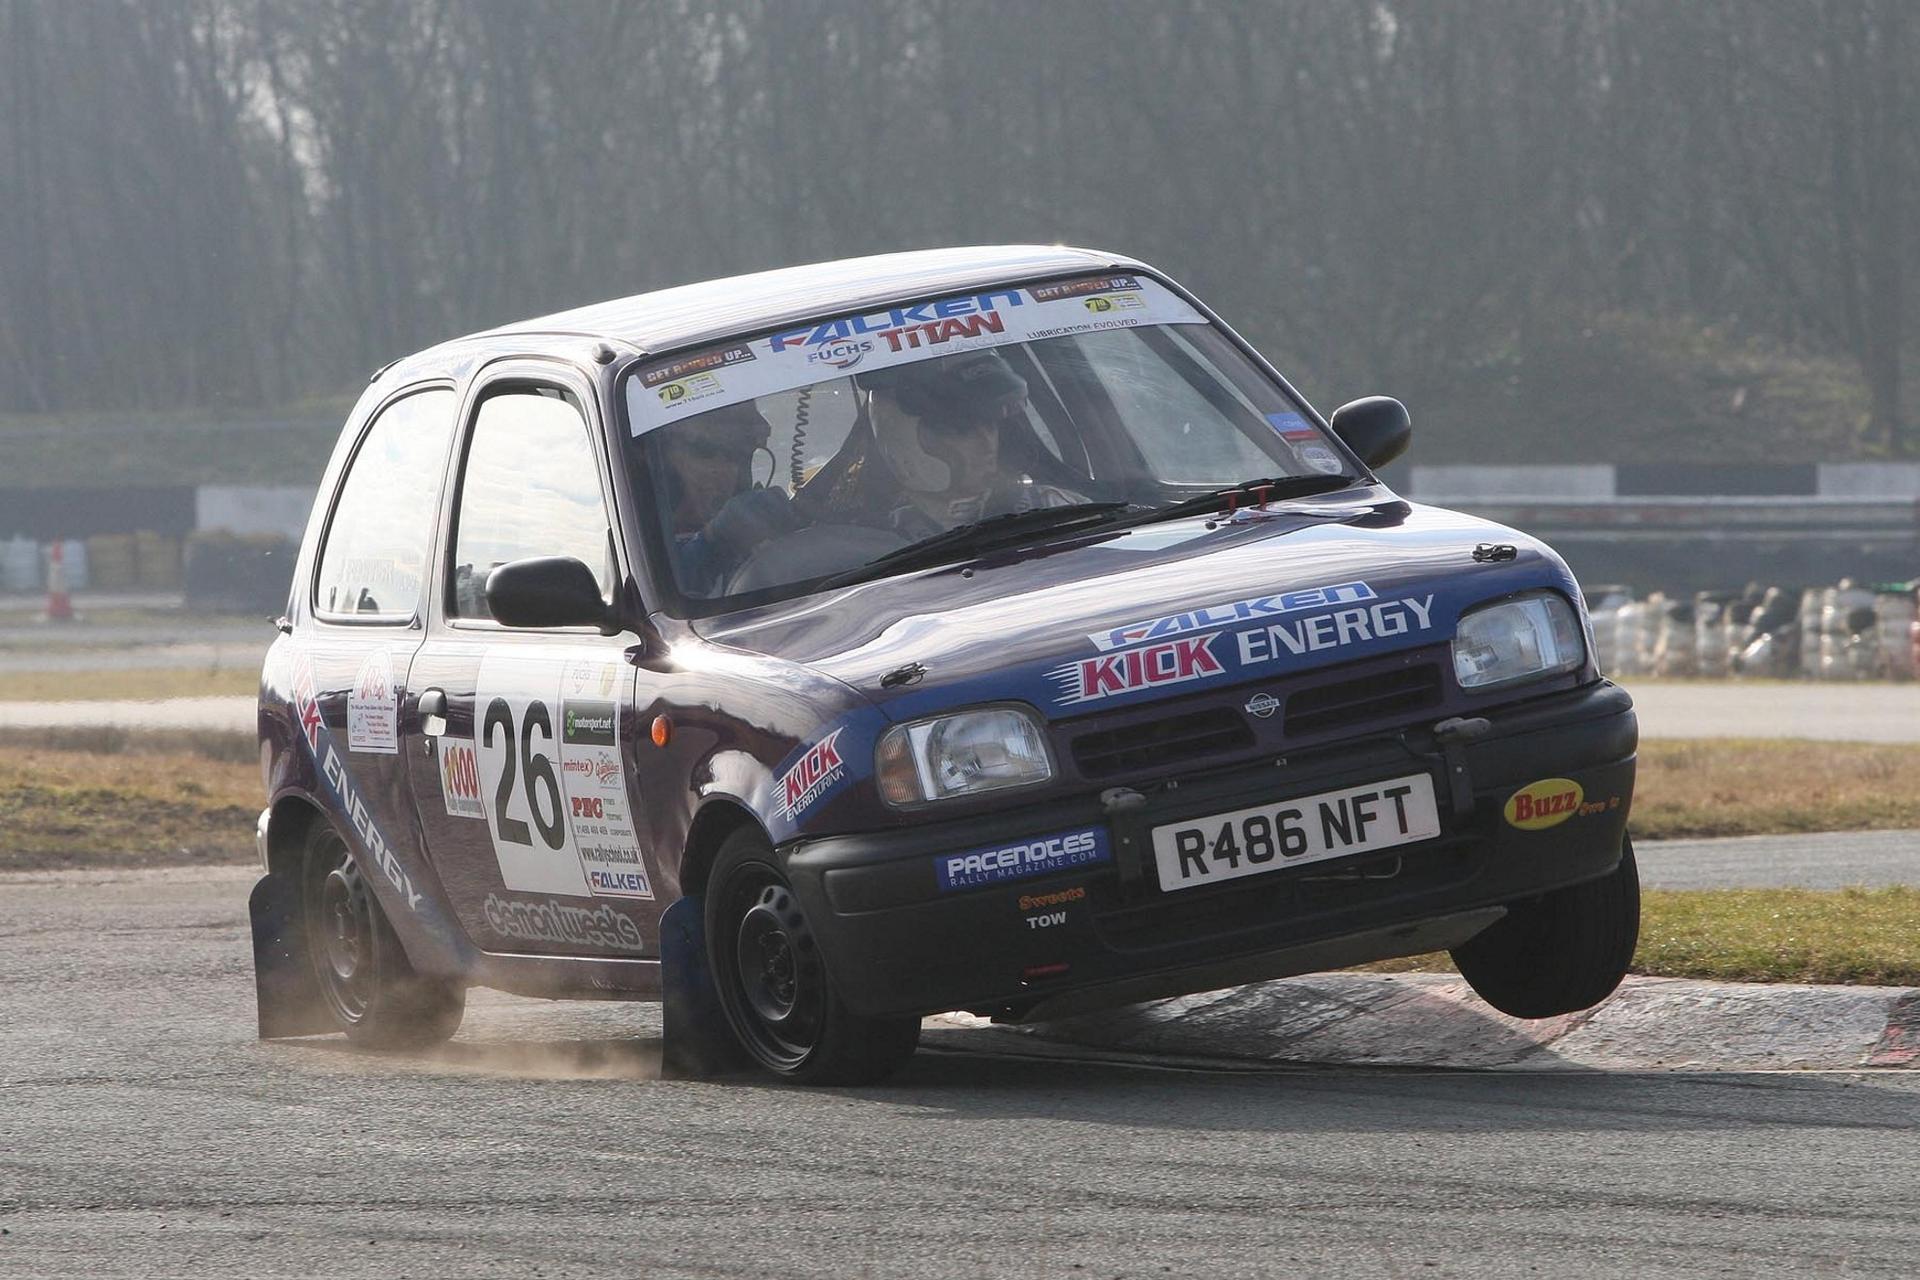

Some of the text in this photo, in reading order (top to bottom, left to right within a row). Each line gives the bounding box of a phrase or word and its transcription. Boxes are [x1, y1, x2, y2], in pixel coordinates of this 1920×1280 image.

[1036, 287, 1059, 299] GET
[768, 290, 1024, 353] FALKEN
[1026, 318, 1138, 339] LUBRICATION EVOLVED
[807, 339, 875, 363] FUCHS
[646, 368, 672, 382] GET
[1108, 584, 1373, 647] FALKEN
[1080, 594, 1434, 697] KICK ENERGY
[574, 717, 611, 731] motorsport.net
[483, 697, 565, 850] 26
[564, 760, 589, 772] mintex
[784, 733, 841, 809] KICK
[1515, 792, 1577, 822] Buzz
[323, 744, 423, 911] ENERGY
[1175, 786, 1411, 878] R486 NFT
[947, 832, 1096, 877] PACENOTES
[950, 851, 1097, 887] RALLY MAGAZINE.COM
[591, 872, 649, 891] FALKEN
[1027, 912, 1066, 929] TOW
